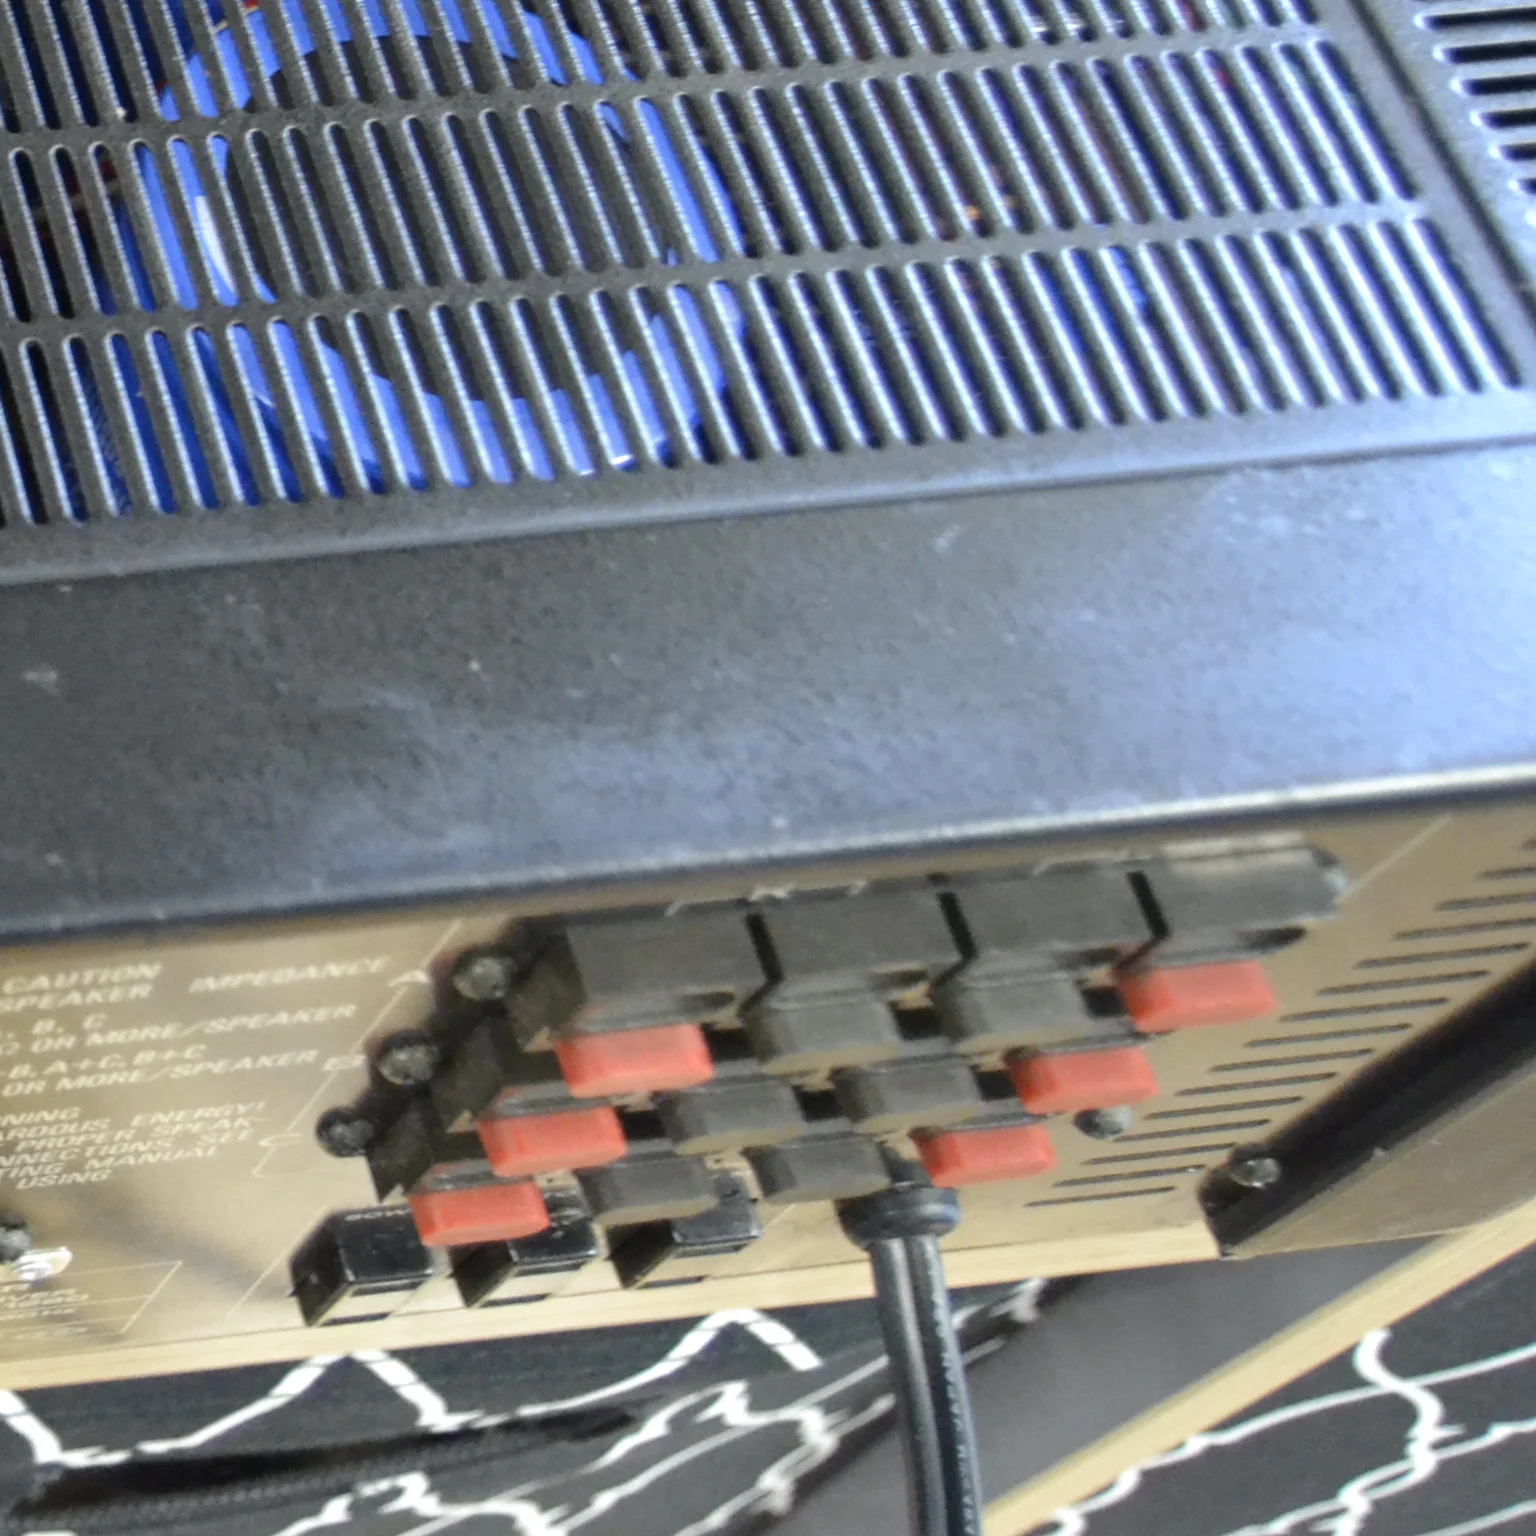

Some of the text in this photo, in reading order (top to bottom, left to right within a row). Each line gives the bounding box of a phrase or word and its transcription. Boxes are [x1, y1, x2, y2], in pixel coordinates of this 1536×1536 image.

[1, 960, 163, 995] CAUTION
[187, 954, 393, 994] IMPEDANCE
[30, 1035, 78, 1054] OR
[86, 1003, 358, 1048] MORE/SPEAKER
[0, 1079, 48, 1098] OR
[54, 1048, 321, 1092] MORE/SPEAKER
[15, 1128, 138, 1153] PROPER
[82, 1144, 218, 1170] MANUAL
[16, 1168, 114, 1190] USING
